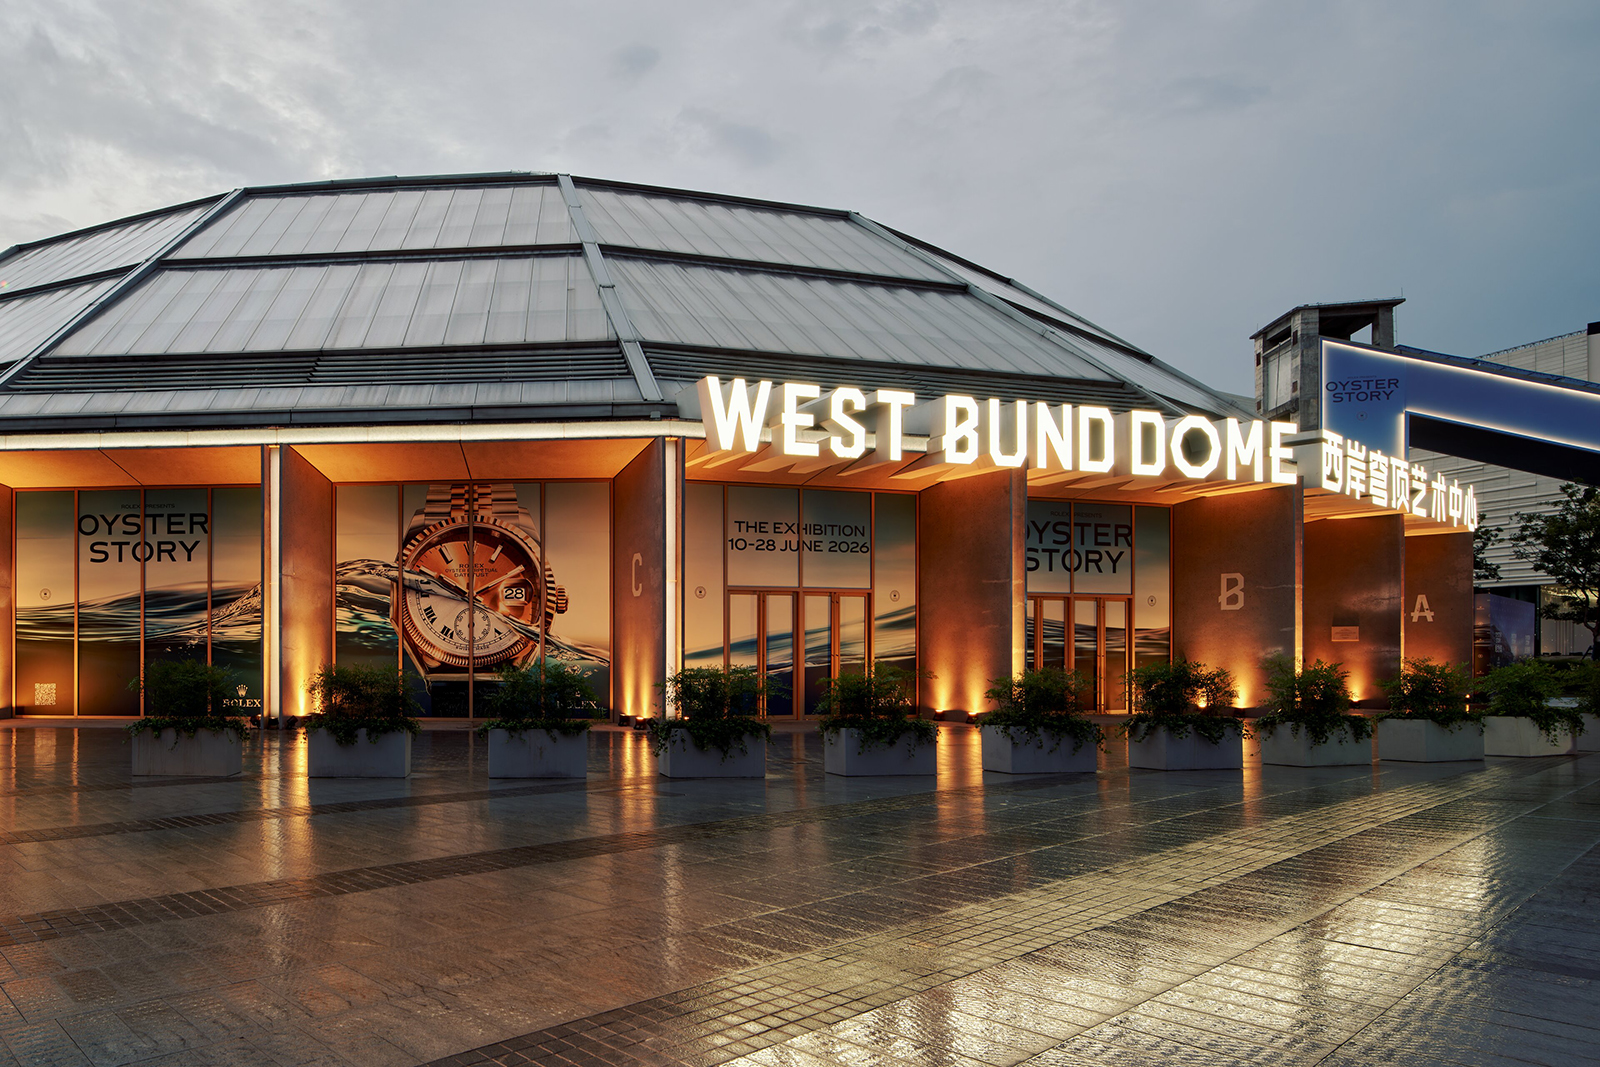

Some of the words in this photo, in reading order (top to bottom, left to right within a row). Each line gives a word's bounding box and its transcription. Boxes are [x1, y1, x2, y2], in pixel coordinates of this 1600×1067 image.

[1325, 378, 1399, 392] OYSTER
[1332, 390, 1394, 403] STORY
[704, 375, 916, 462] WEST
[942, 393, 1115, 473] BUND
[1130, 409, 1298, 485] DOME
[1321, 428, 1478, 533] 西岸穹顶艺术中心
[78, 512, 208, 536] OYSTER
[734, 520, 769, 534] THE
[773, 522, 866, 537] EXHIBITION
[1026, 520, 1132, 548] YSTER
[89, 540, 200, 563] STORY
[728, 538, 776, 552] 10-28
[779, 540, 824, 552] JUNE
[828, 541, 870, 554] 2026
[631, 552, 643, 597] C
[504, 587, 524, 600] 28
[1218, 572, 1245, 610] B
[1410, 594, 1435, 622] A
